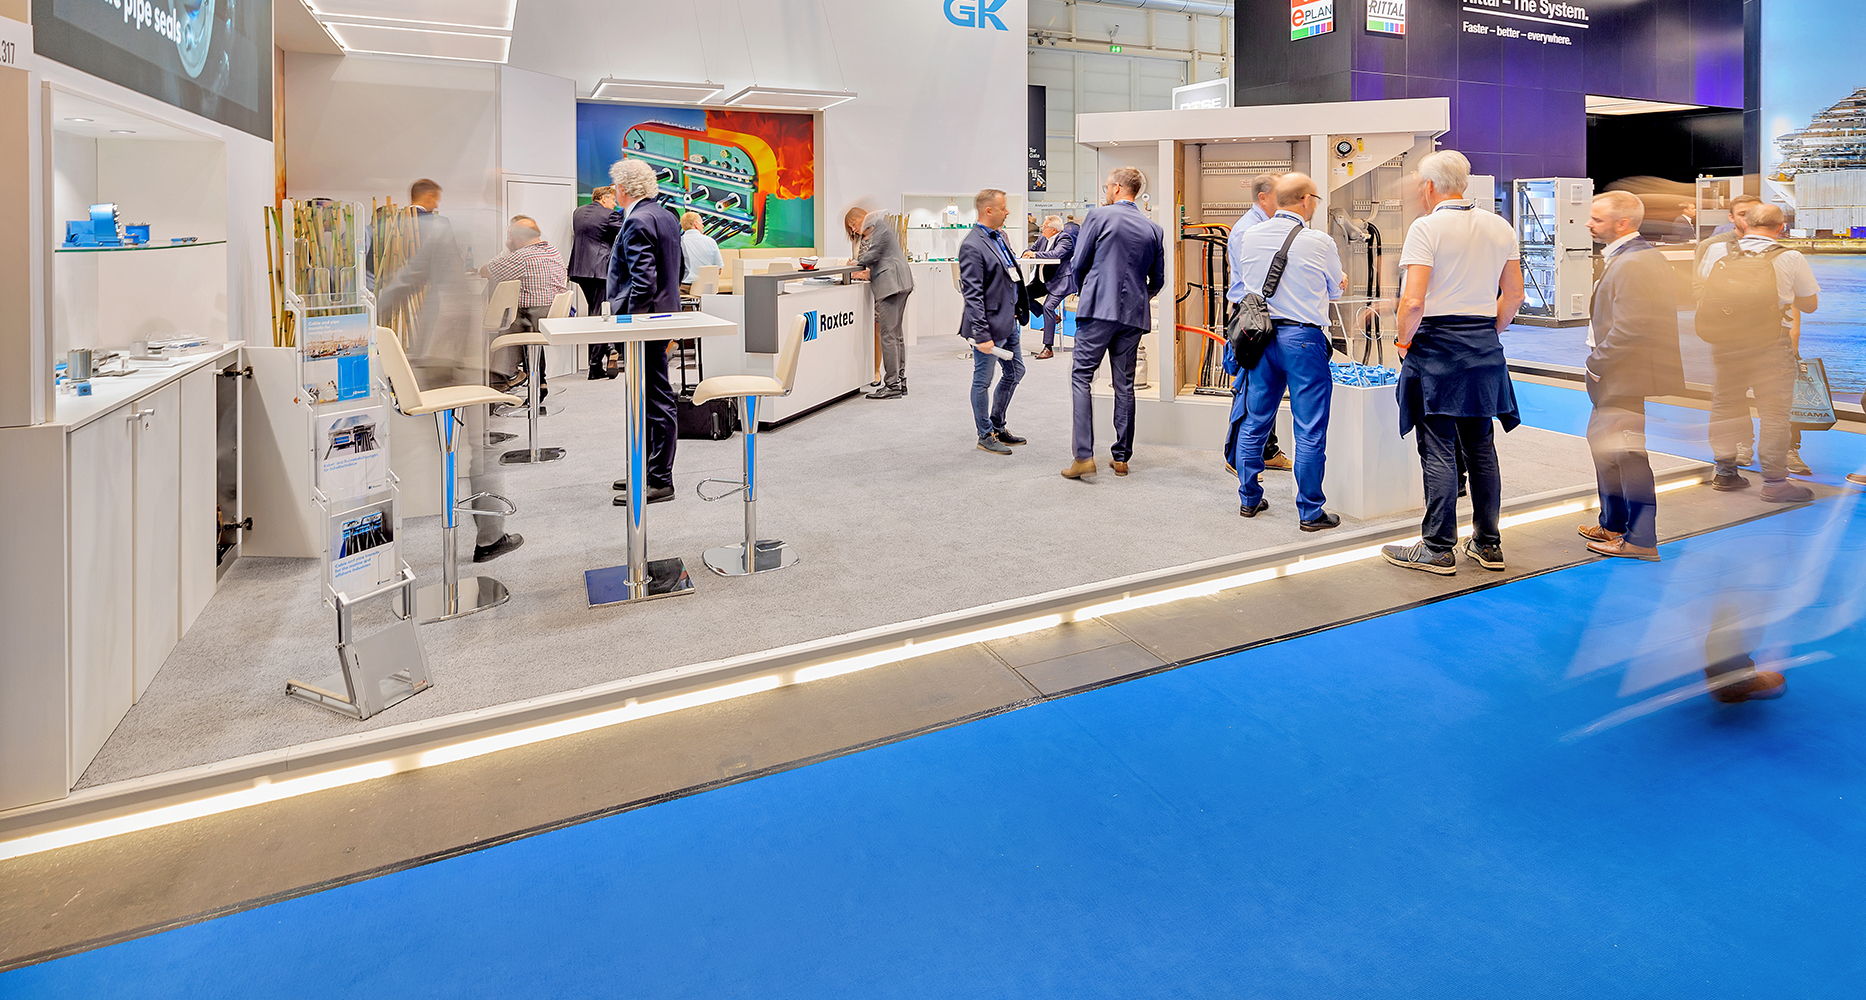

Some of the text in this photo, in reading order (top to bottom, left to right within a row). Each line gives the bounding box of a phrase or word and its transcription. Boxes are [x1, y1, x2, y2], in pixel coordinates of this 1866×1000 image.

[1369, 0, 1404, 17] RITTAL
[154, 7, 182, 45] seals
[1463, 21, 1489, 35] Faster
[1496, 25, 1520, 39] better
[1527, 31, 1572, 45] everywhere.
[1038, 159, 1046, 167] 10
[820, 310, 854, 332] Roxtec
